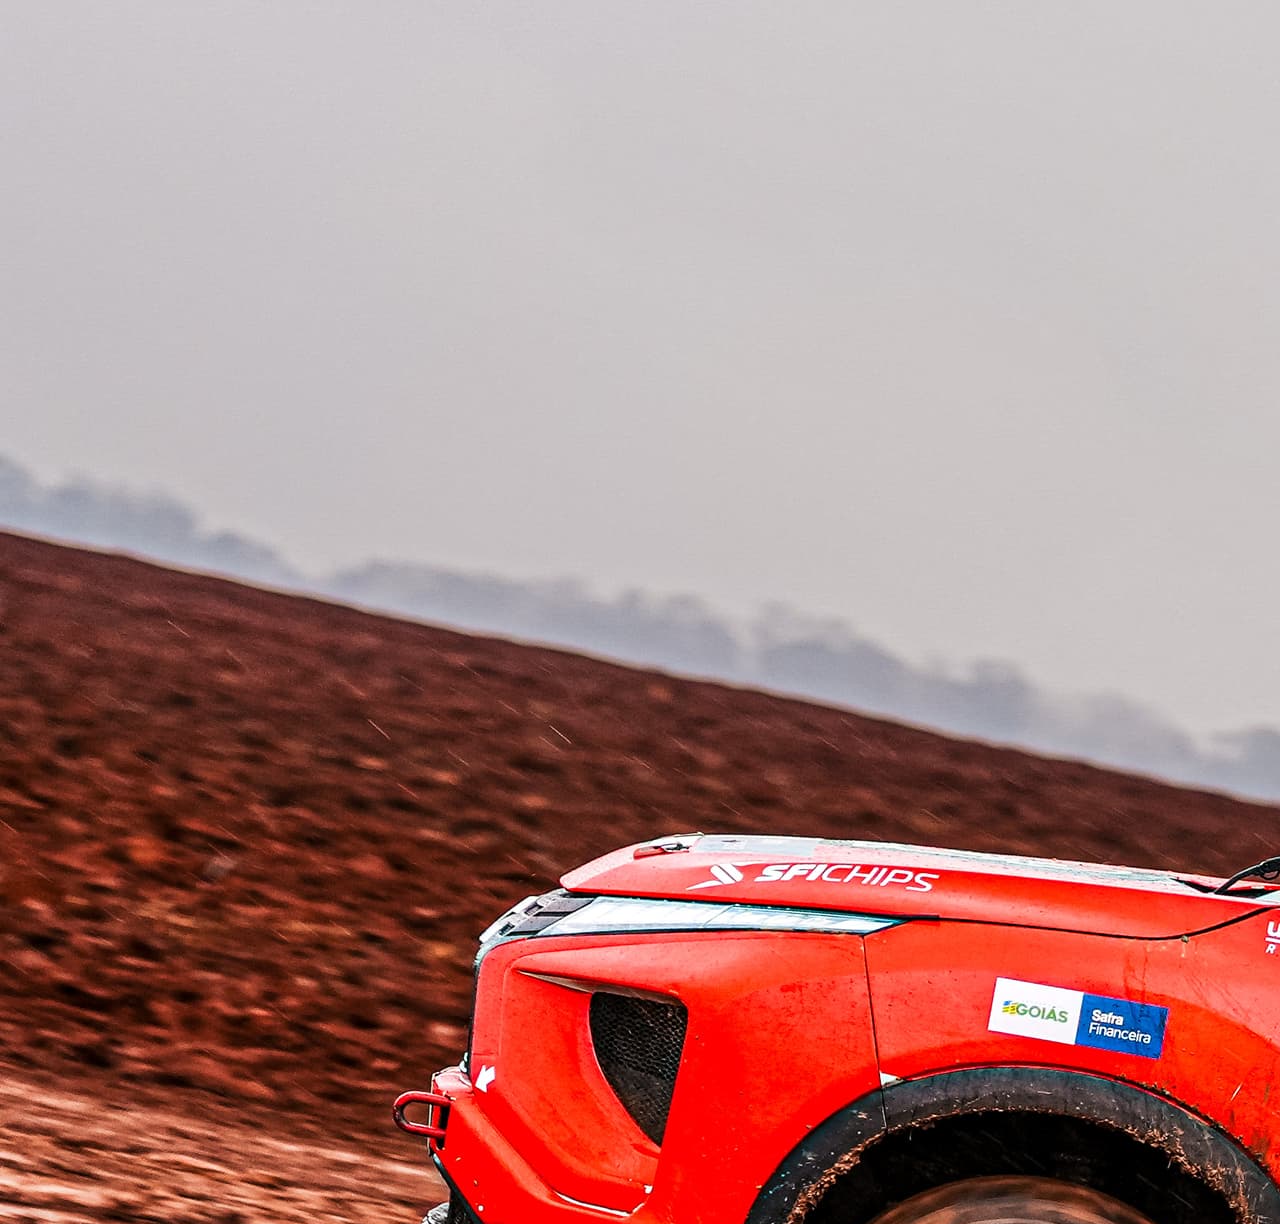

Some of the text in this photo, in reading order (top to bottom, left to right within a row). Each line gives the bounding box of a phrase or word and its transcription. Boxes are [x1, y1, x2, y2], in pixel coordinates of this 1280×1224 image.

[754, 863, 940, 892] SFICHIPS
[1091, 1009, 1124, 1026] Safra
[1089, 1021, 1152, 1044] Financeira
